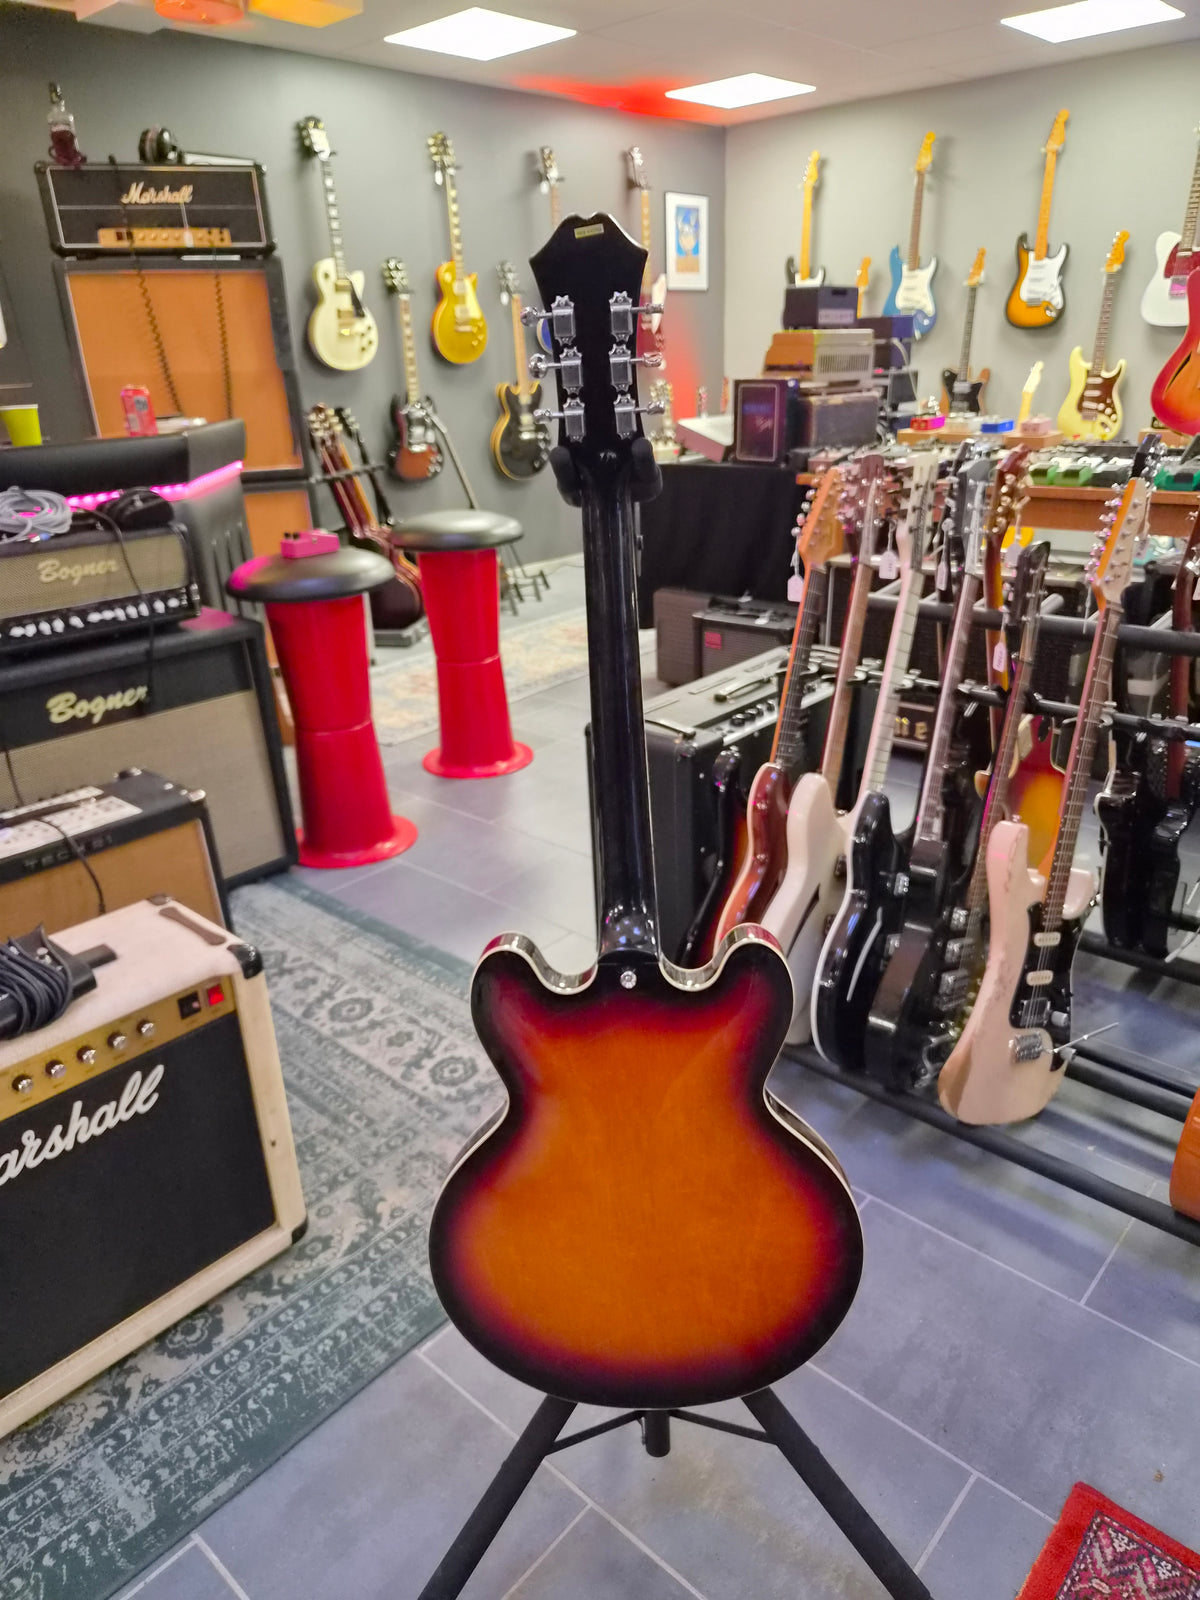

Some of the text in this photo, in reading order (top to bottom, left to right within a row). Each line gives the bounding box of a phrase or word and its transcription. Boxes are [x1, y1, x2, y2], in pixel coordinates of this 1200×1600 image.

[120, 181, 193, 204] Marshall
[37, 558, 118, 586] Bogner
[46, 685, 148, 724] Bogner
[0, 1064, 165, 1186] arshall
